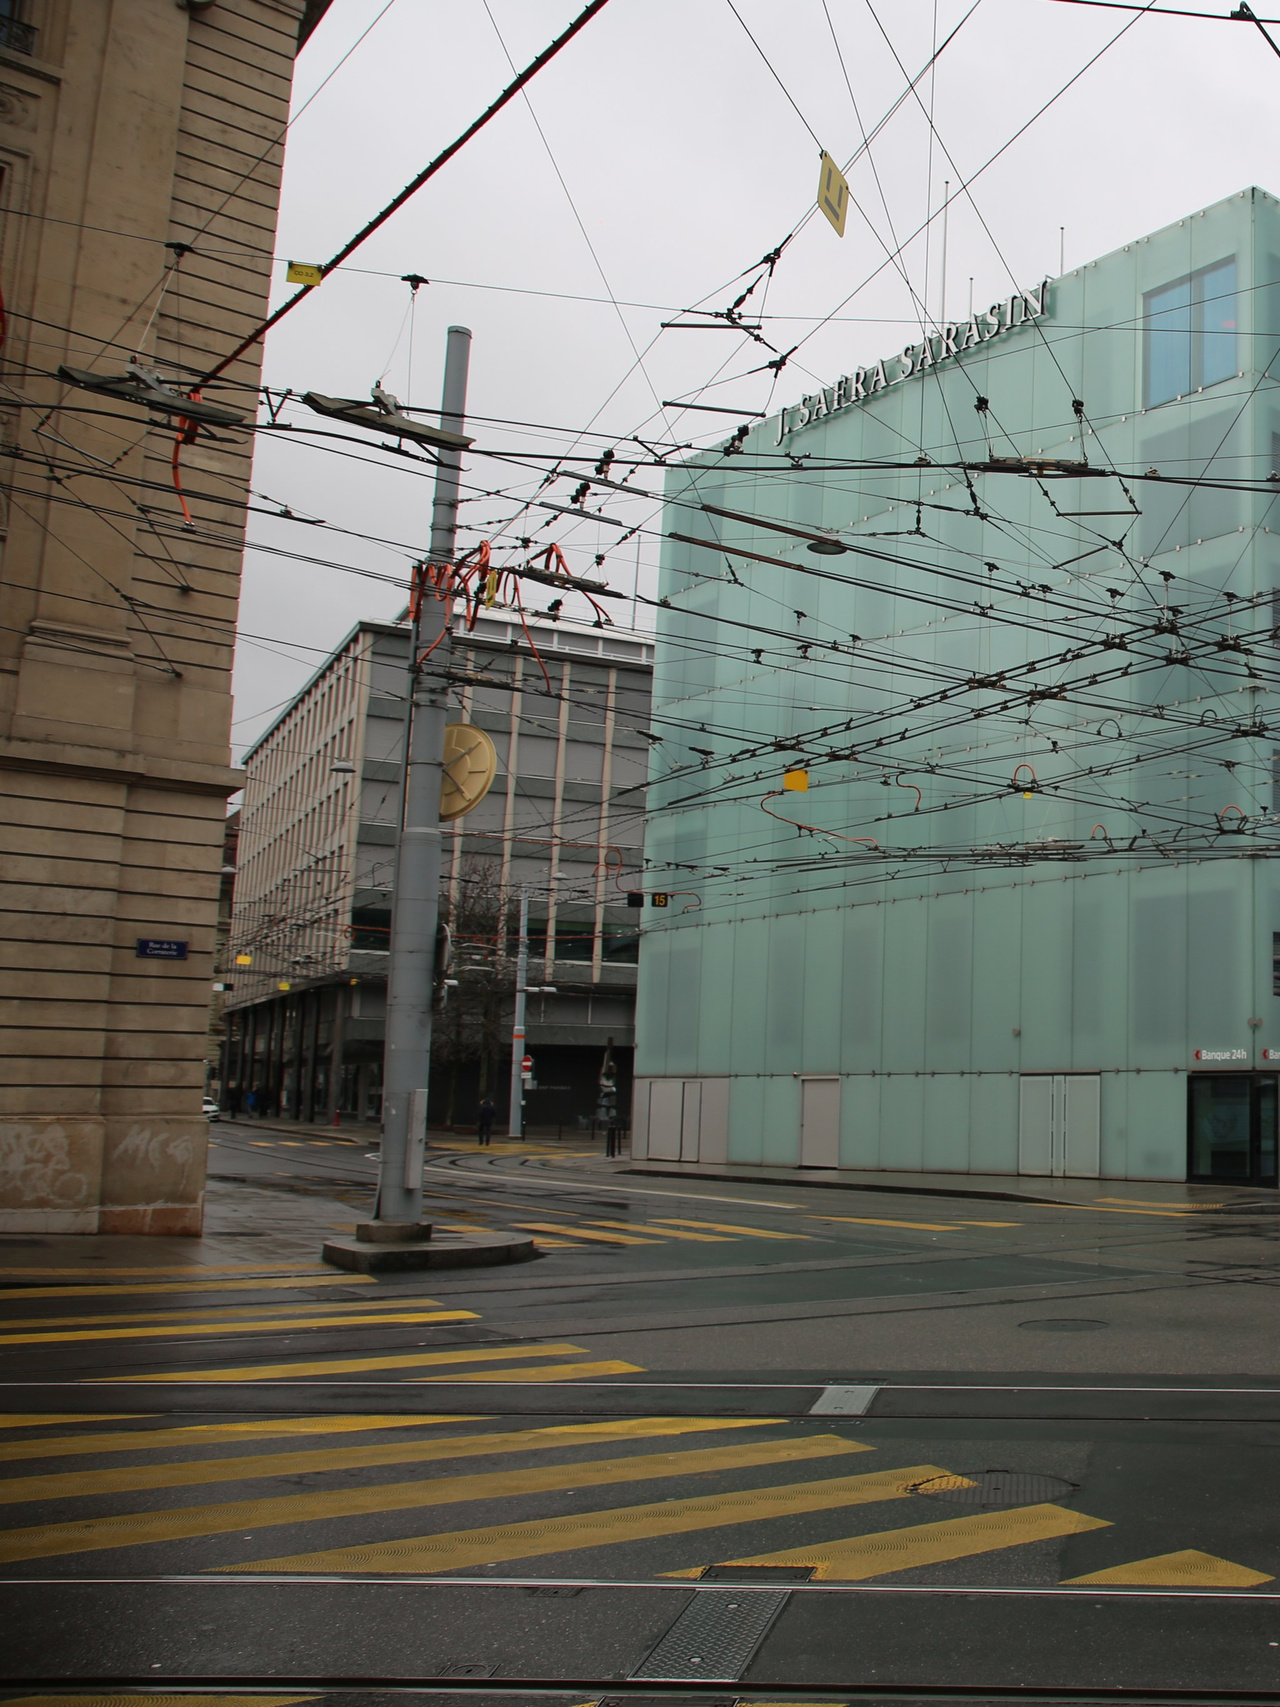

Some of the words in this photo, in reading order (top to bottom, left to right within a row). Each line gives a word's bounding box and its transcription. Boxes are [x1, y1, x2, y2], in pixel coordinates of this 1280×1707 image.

[774, 407, 792, 446] J.
[799, 358, 890, 426] SAFRA
[899, 279, 1049, 379] SARASIN
[654, 894, 666, 906] 15
[1202, 1049, 1231, 1061] Banque
[1231, 1049, 1247, 1060] 24h
